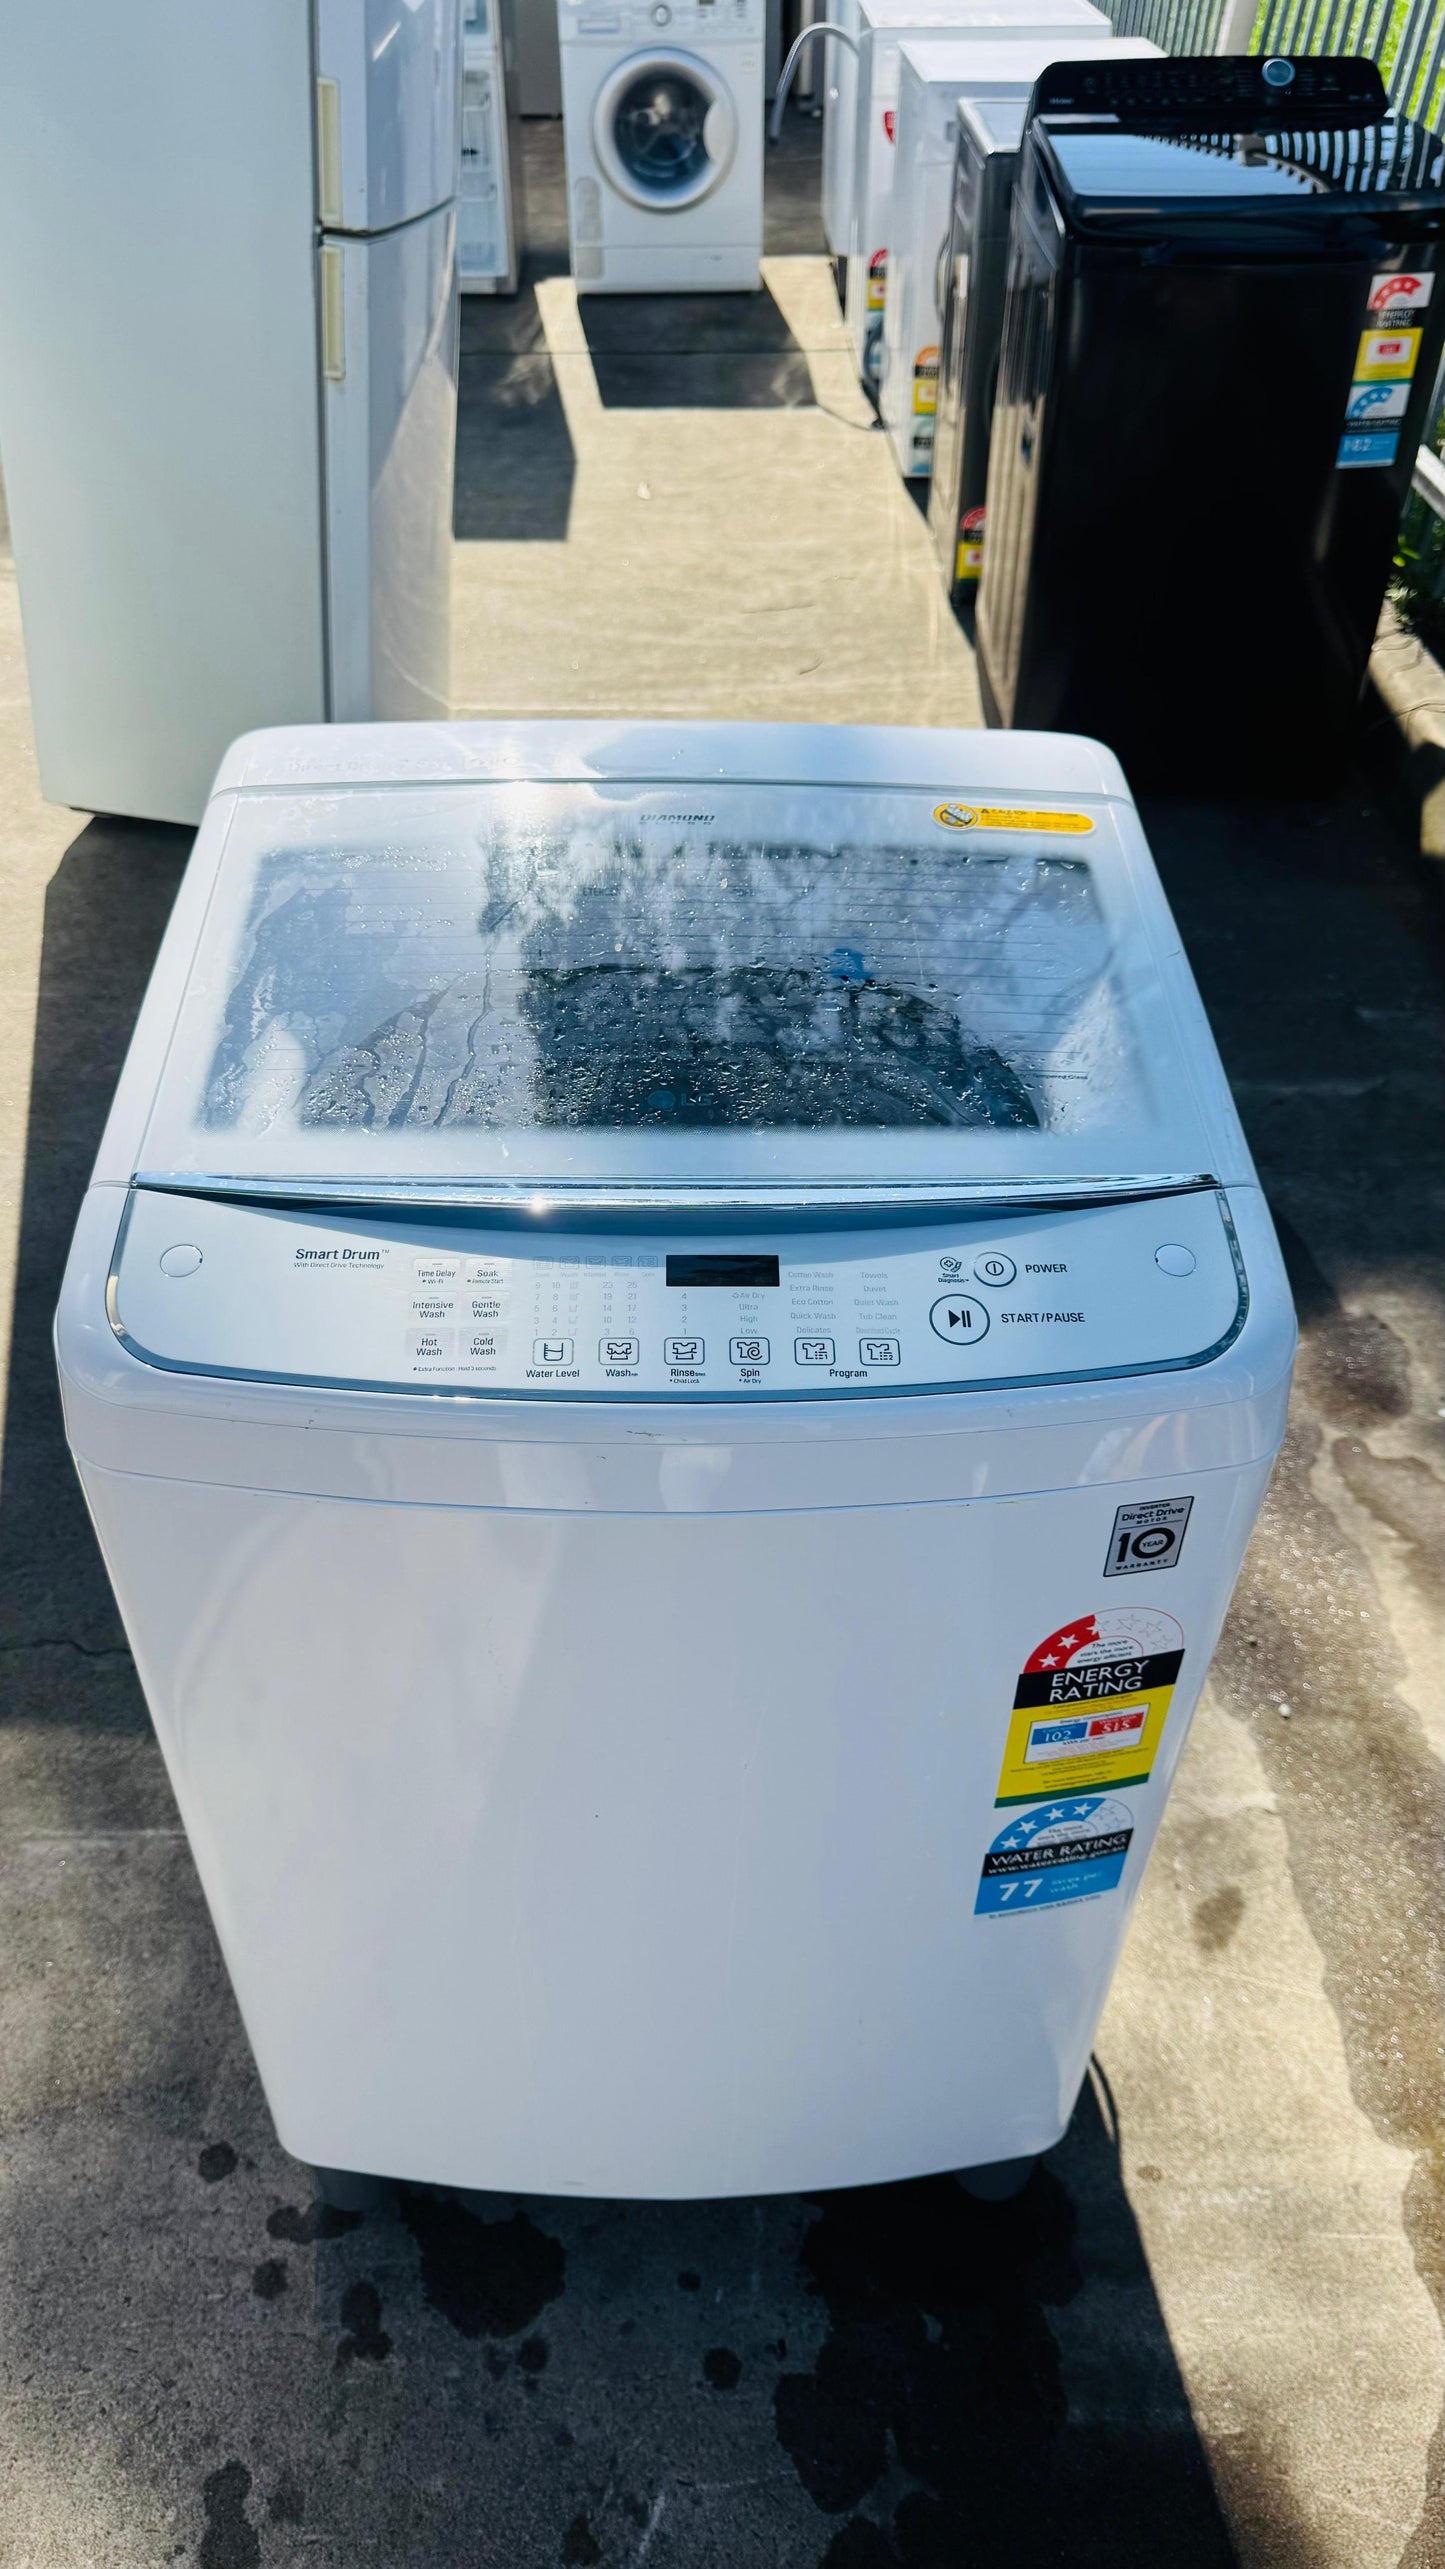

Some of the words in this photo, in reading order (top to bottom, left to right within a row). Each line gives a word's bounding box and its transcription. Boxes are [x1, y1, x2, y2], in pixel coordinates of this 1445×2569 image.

[295, 1248, 339, 1260] Smart
[1025, 1263, 1068, 1273] POWER
[418, 1269, 434, 1277] Time
[436, 1269, 456, 1279] Delay
[477, 1269, 499, 1278] Soak
[788, 1271, 812, 1279] Cotton
[813, 1271, 834, 1279] Wash
[861, 1271, 888, 1279] Towels
[552, 1281, 560, 1289] 10
[602, 1281, 613, 1289] 23
[790, 1284, 811, 1292] Extra
[812, 1284, 834, 1292] Rinse
[681, 1292, 687, 1300] 4
[752, 1292, 765, 1300] Dry
[412, 1301, 454, 1310] Intensive
[471, 1300, 502, 1309] Gentle
[791, 1298, 806, 1306] Eco
[807, 1298, 834, 1306] Cotton
[876, 1298, 899, 1306] Wash
[603, 1304, 612, 1312] 14
[681, 1304, 687, 1312] 3
[419, 1310, 445, 1319] Wash
[473, 1310, 499, 1318] Wash
[790, 1312, 811, 1320] Quick
[814, 1312, 836, 1320] Wash
[875, 1312, 897, 1320] Clean
[1001, 1312, 1086, 1323] START/PAUSE
[551, 1316, 558, 1324] 4
[603, 1316, 612, 1324] 10
[740, 1315, 758, 1323] High
[796, 1326, 831, 1334] Delicates
[421, 1338, 438, 1346] Hot
[473, 1337, 494, 1346] Cold
[416, 1348, 442, 1356] Wash
[470, 1347, 496, 1356] Wash
[526, 1369, 554, 1378] Water
[555, 1369, 580, 1378] Level
[605, 1369, 631, 1377] Wash
[670, 1368, 695, 1377] Rinse
[740, 1368, 760, 1378] Spin
[829, 1369, 868, 1379] Program
[1121, 1511, 1154, 1521] Direct
[1156, 1507, 1185, 1517] Drive
[1136, 1516, 1168, 1525] MOTOR
[1116, 1527, 1176, 1563] 10
[1142, 1539, 1165, 1548] YEAR
[1115, 1558, 1169, 1571] WARRANTY
[1052, 1659, 1150, 1687] ENERGY
[1049, 1676, 1144, 1703] RATING
[1102, 1720, 1132, 1733] 515
[1045, 1730, 1071, 1742] 102
[991, 1848, 1055, 1867] WATER
[1060, 1833, 1128, 1857] RATING
[999, 1877, 1043, 1902] 77
